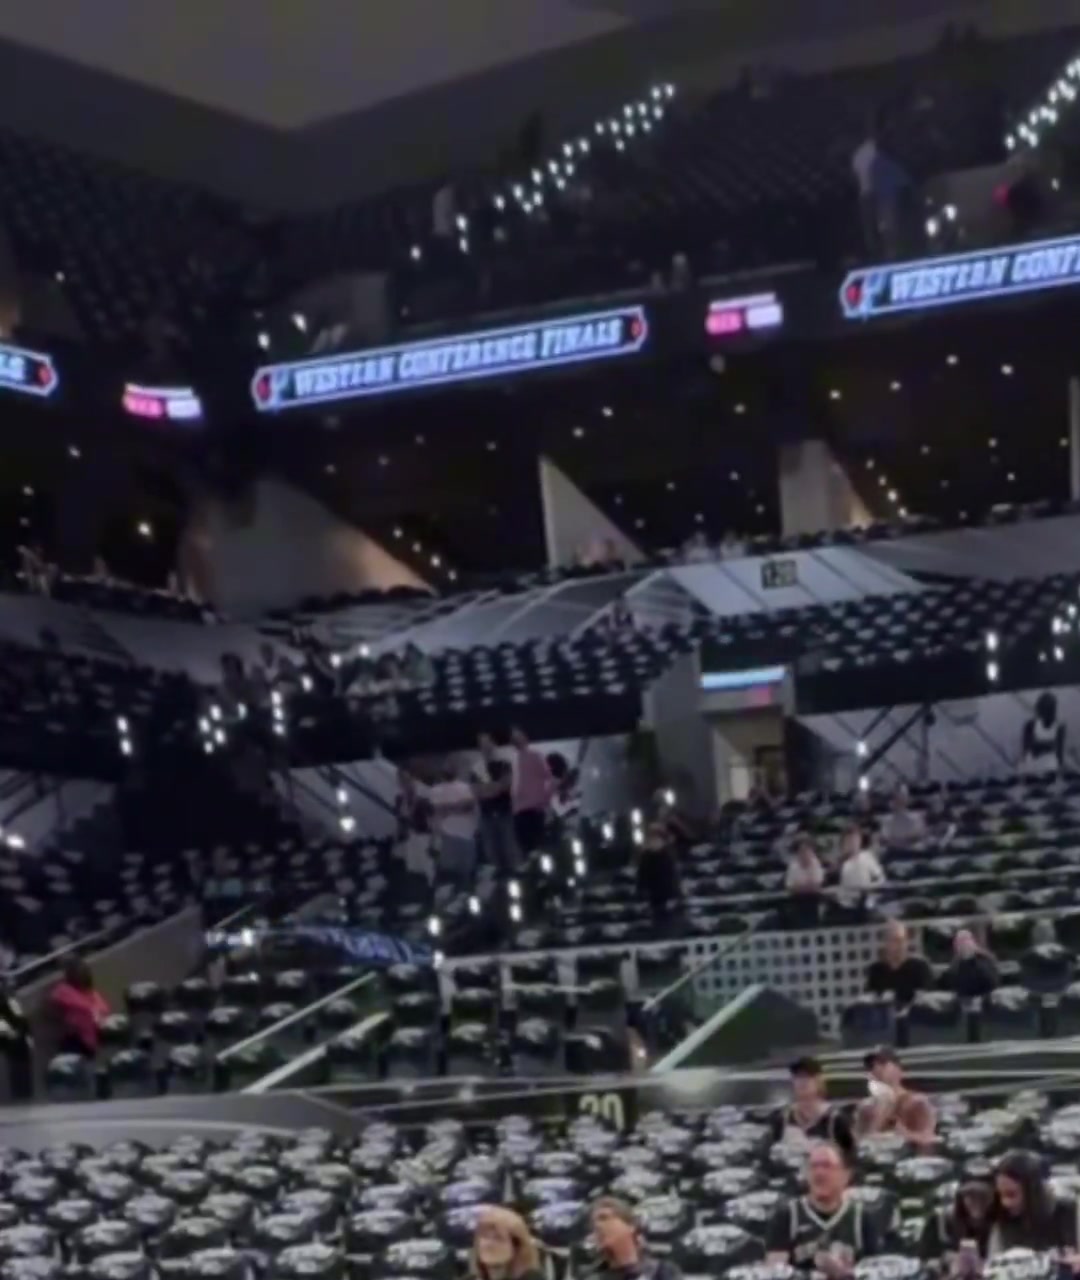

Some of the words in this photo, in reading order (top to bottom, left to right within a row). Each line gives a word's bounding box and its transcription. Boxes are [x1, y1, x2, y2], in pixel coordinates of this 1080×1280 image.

[889, 252, 1012, 302] WESTERN
[398, 330, 537, 380] CONFERENCE
[539, 318, 624, 357] FINALS
